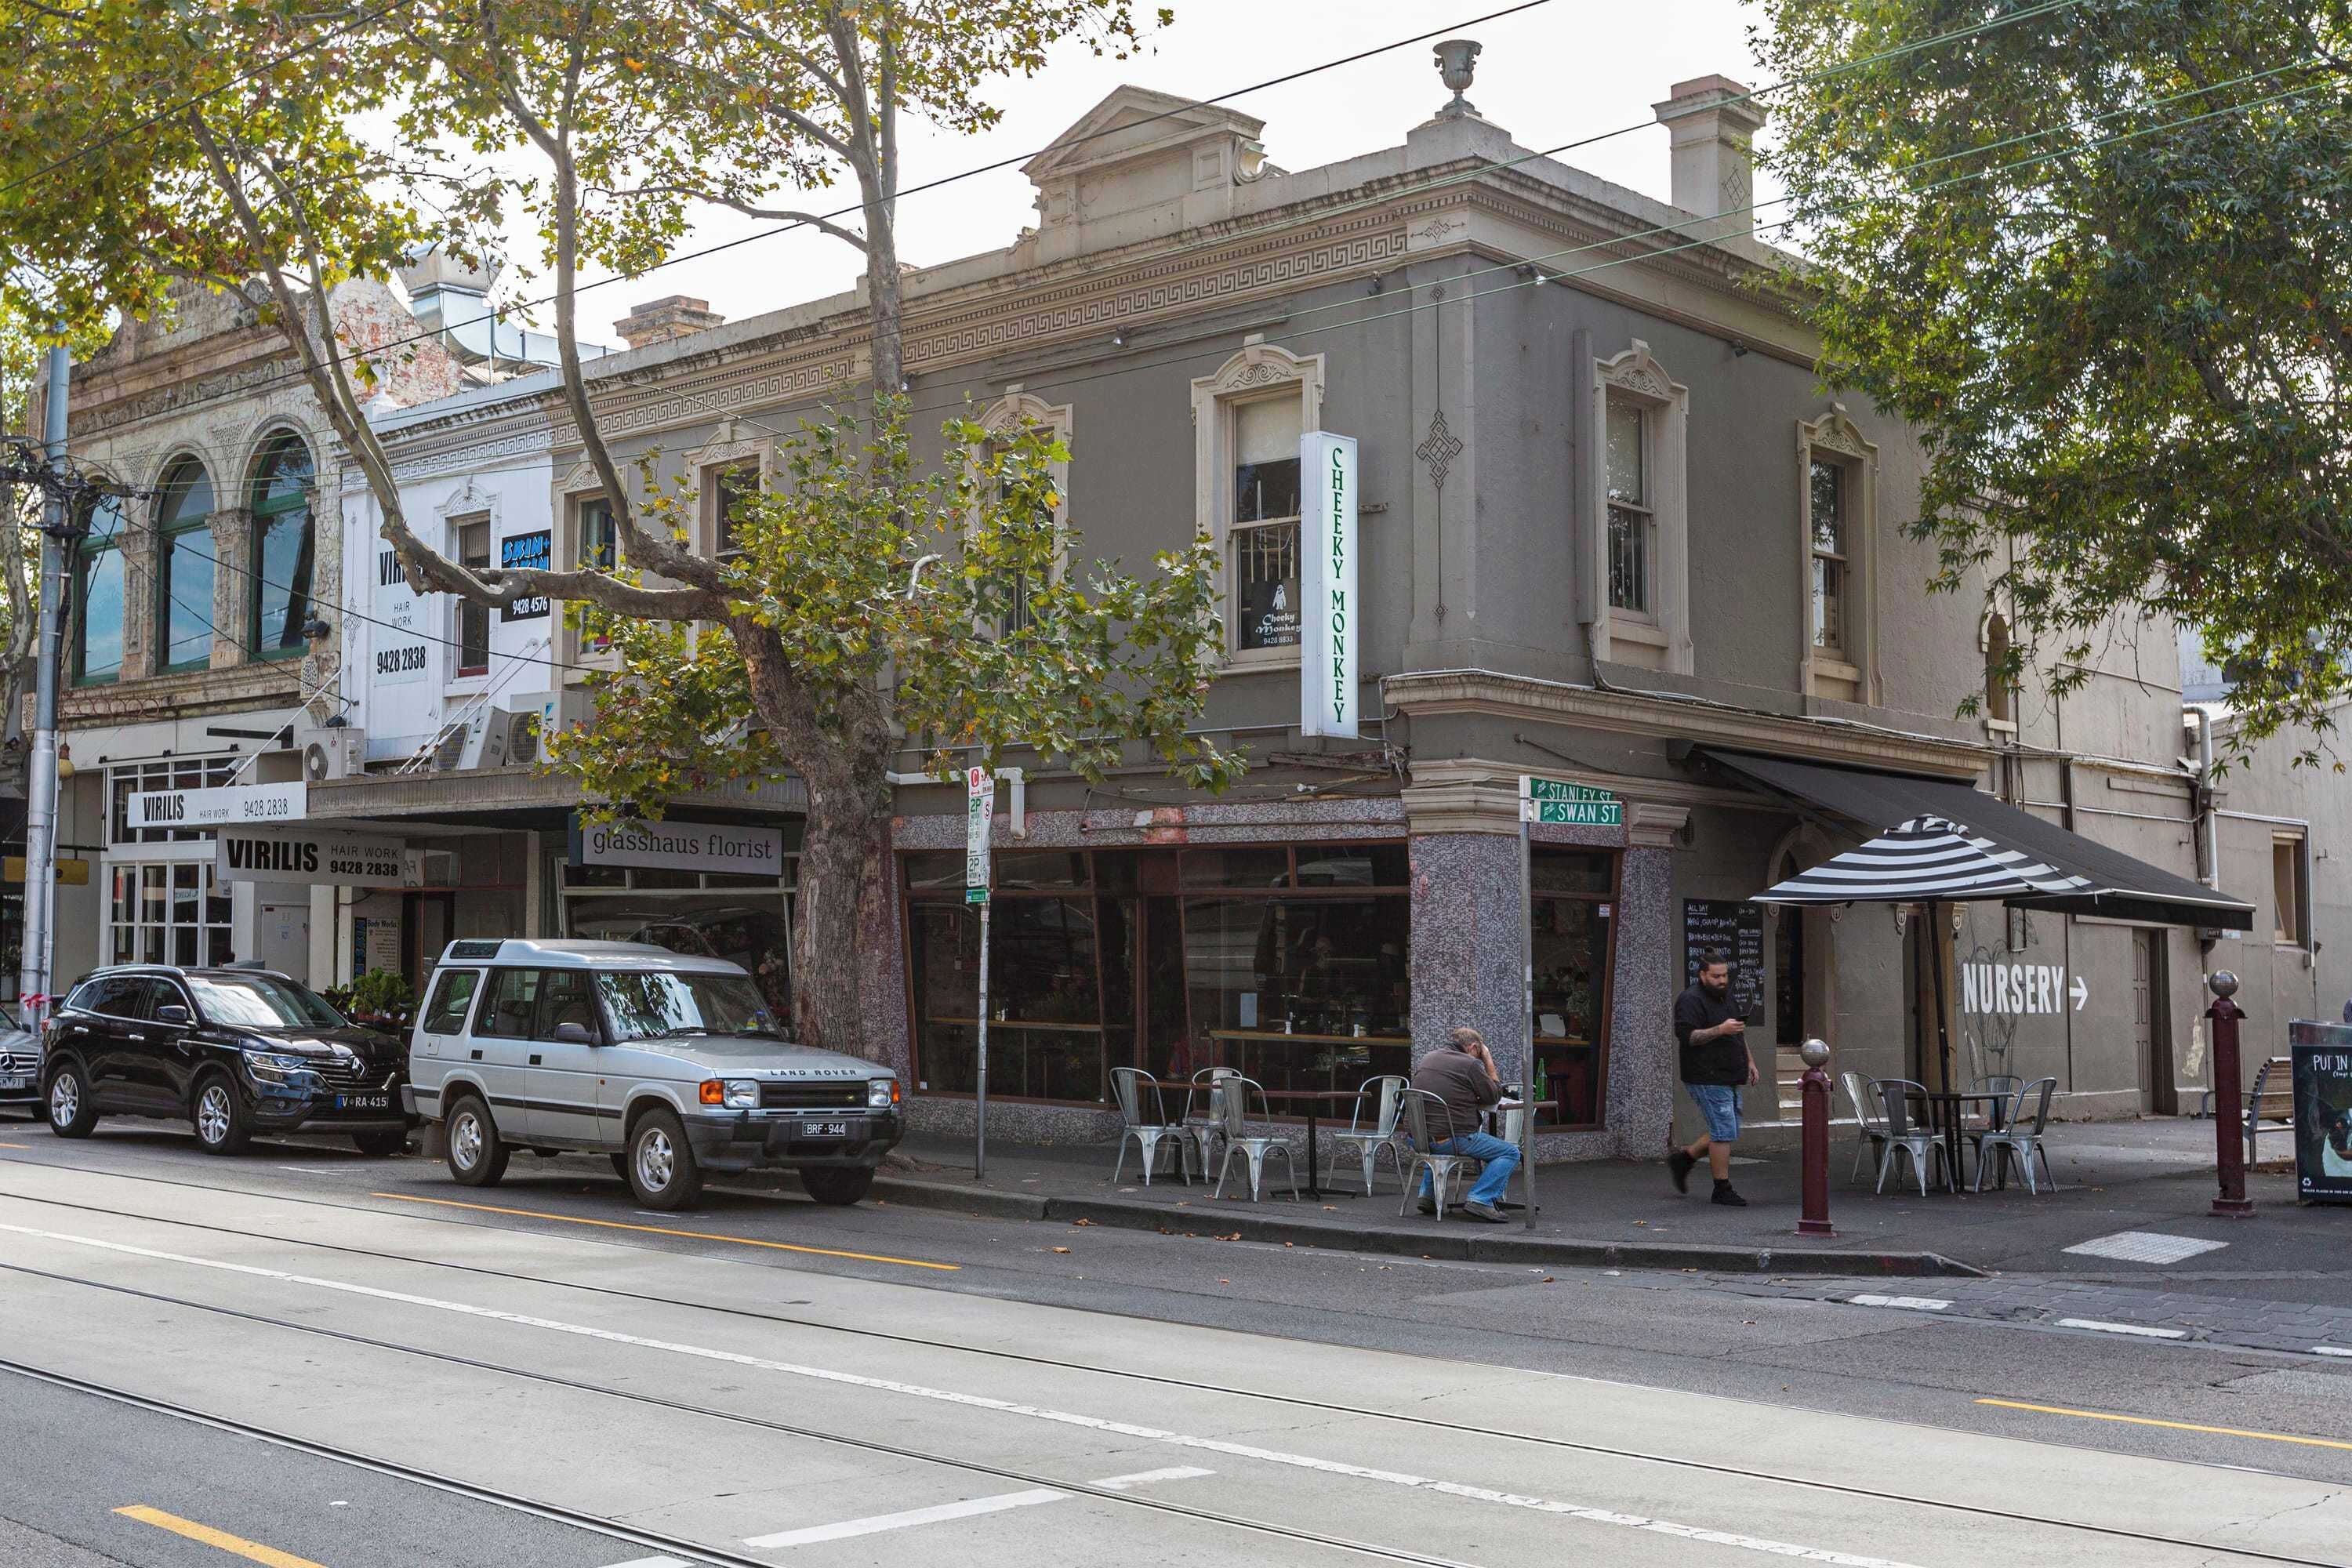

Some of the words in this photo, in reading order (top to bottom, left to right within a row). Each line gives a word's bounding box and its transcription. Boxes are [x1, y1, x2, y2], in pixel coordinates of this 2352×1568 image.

[1332, 448, 1344, 579] CHEEKY
[394, 601, 410, 613] HAIR
[513, 598, 529, 615] 9428
[531, 596, 548, 612] 4576
[391, 615, 412, 628] WORK
[1262, 612, 1294, 625] Cheeky
[1255, 624, 1301, 635] Monkey
[377, 649, 400, 674] 9428
[402, 645, 426, 670] 2838
[1331, 589, 1345, 723] MONKEY
[971, 798, 981, 812] 2P
[1599, 791, 1611, 802] ST
[143, 794, 183, 822] VIRILIS
[199, 810, 212, 819] HAIR
[213, 808, 230, 818] WORK
[244, 800, 263, 817] 9428
[267, 797, 289, 816] 2838
[1557, 803, 1596, 822] SWAN
[1601, 804, 1617, 822] ST
[331, 845, 358, 857] HAIR
[365, 847, 398, 859] WORK
[593, 827, 699, 855] glasshaus
[707, 834, 772, 859] florist
[227, 838, 318, 872] VIRILIS
[330, 860, 362, 874] 9428
[366, 862, 398, 877] 2838
[969, 858, 979, 872] 2P
[1963, 964, 2063, 1014] NURSERY
[2314, 1054, 2333, 1072] PUT
[2335, 1054, 2347, 1071] IN
